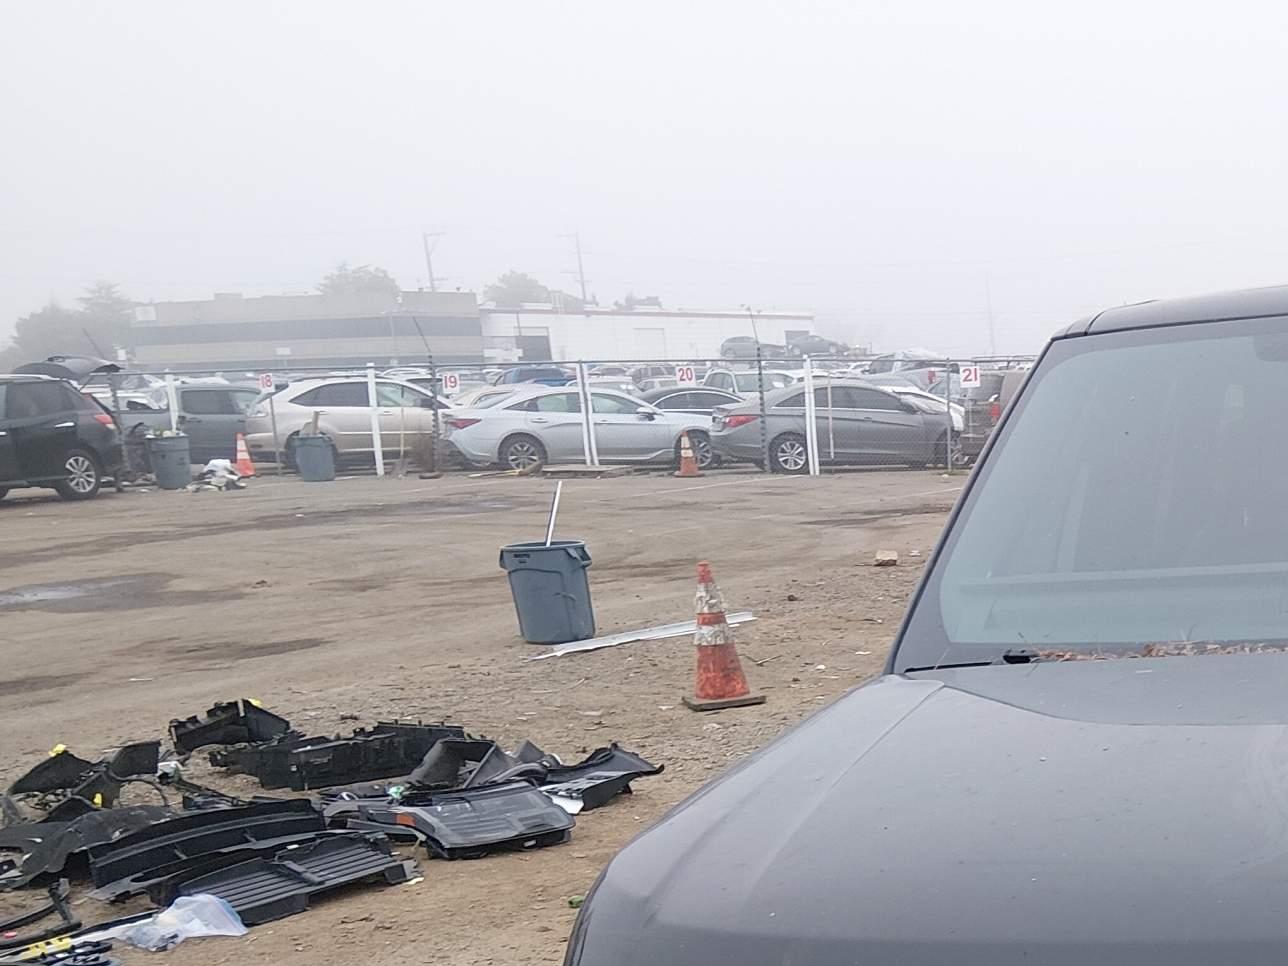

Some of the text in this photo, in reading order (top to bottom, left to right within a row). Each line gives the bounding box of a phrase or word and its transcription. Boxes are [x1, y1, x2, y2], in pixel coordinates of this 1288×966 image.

[260, 374, 272, 387] 18
[678, 367, 694, 382] 20
[962, 368, 977, 383] 21
[443, 375, 458, 389] 19
